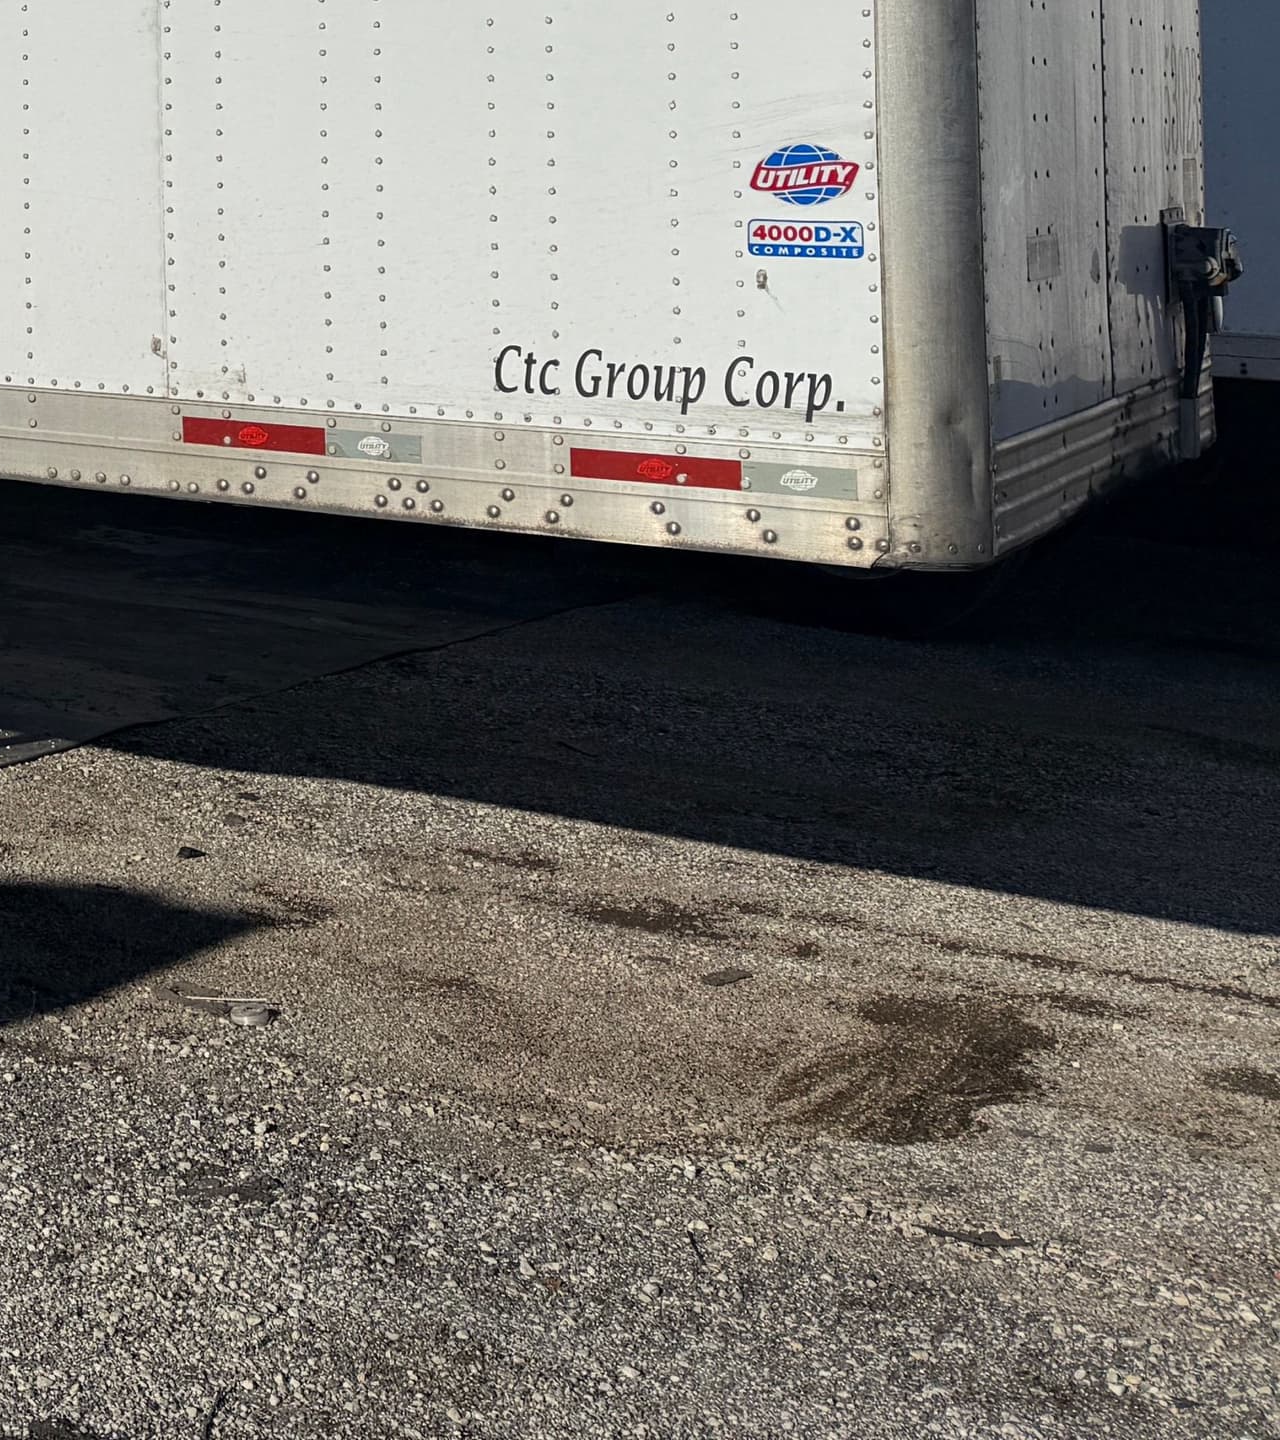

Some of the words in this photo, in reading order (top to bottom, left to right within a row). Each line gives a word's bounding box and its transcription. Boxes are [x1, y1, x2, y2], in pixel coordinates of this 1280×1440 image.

[756, 163, 854, 189] UTILITY
[752, 224, 858, 244] 4000D-X
[752, 245, 859, 257] COMPOSITE
[493, 345, 560, 395] Ctc
[575, 348, 706, 416] Group
[724, 356, 845, 423] Corp.
[359, 442, 387, 451] UTILITY
[782, 476, 815, 485] UTILITY
